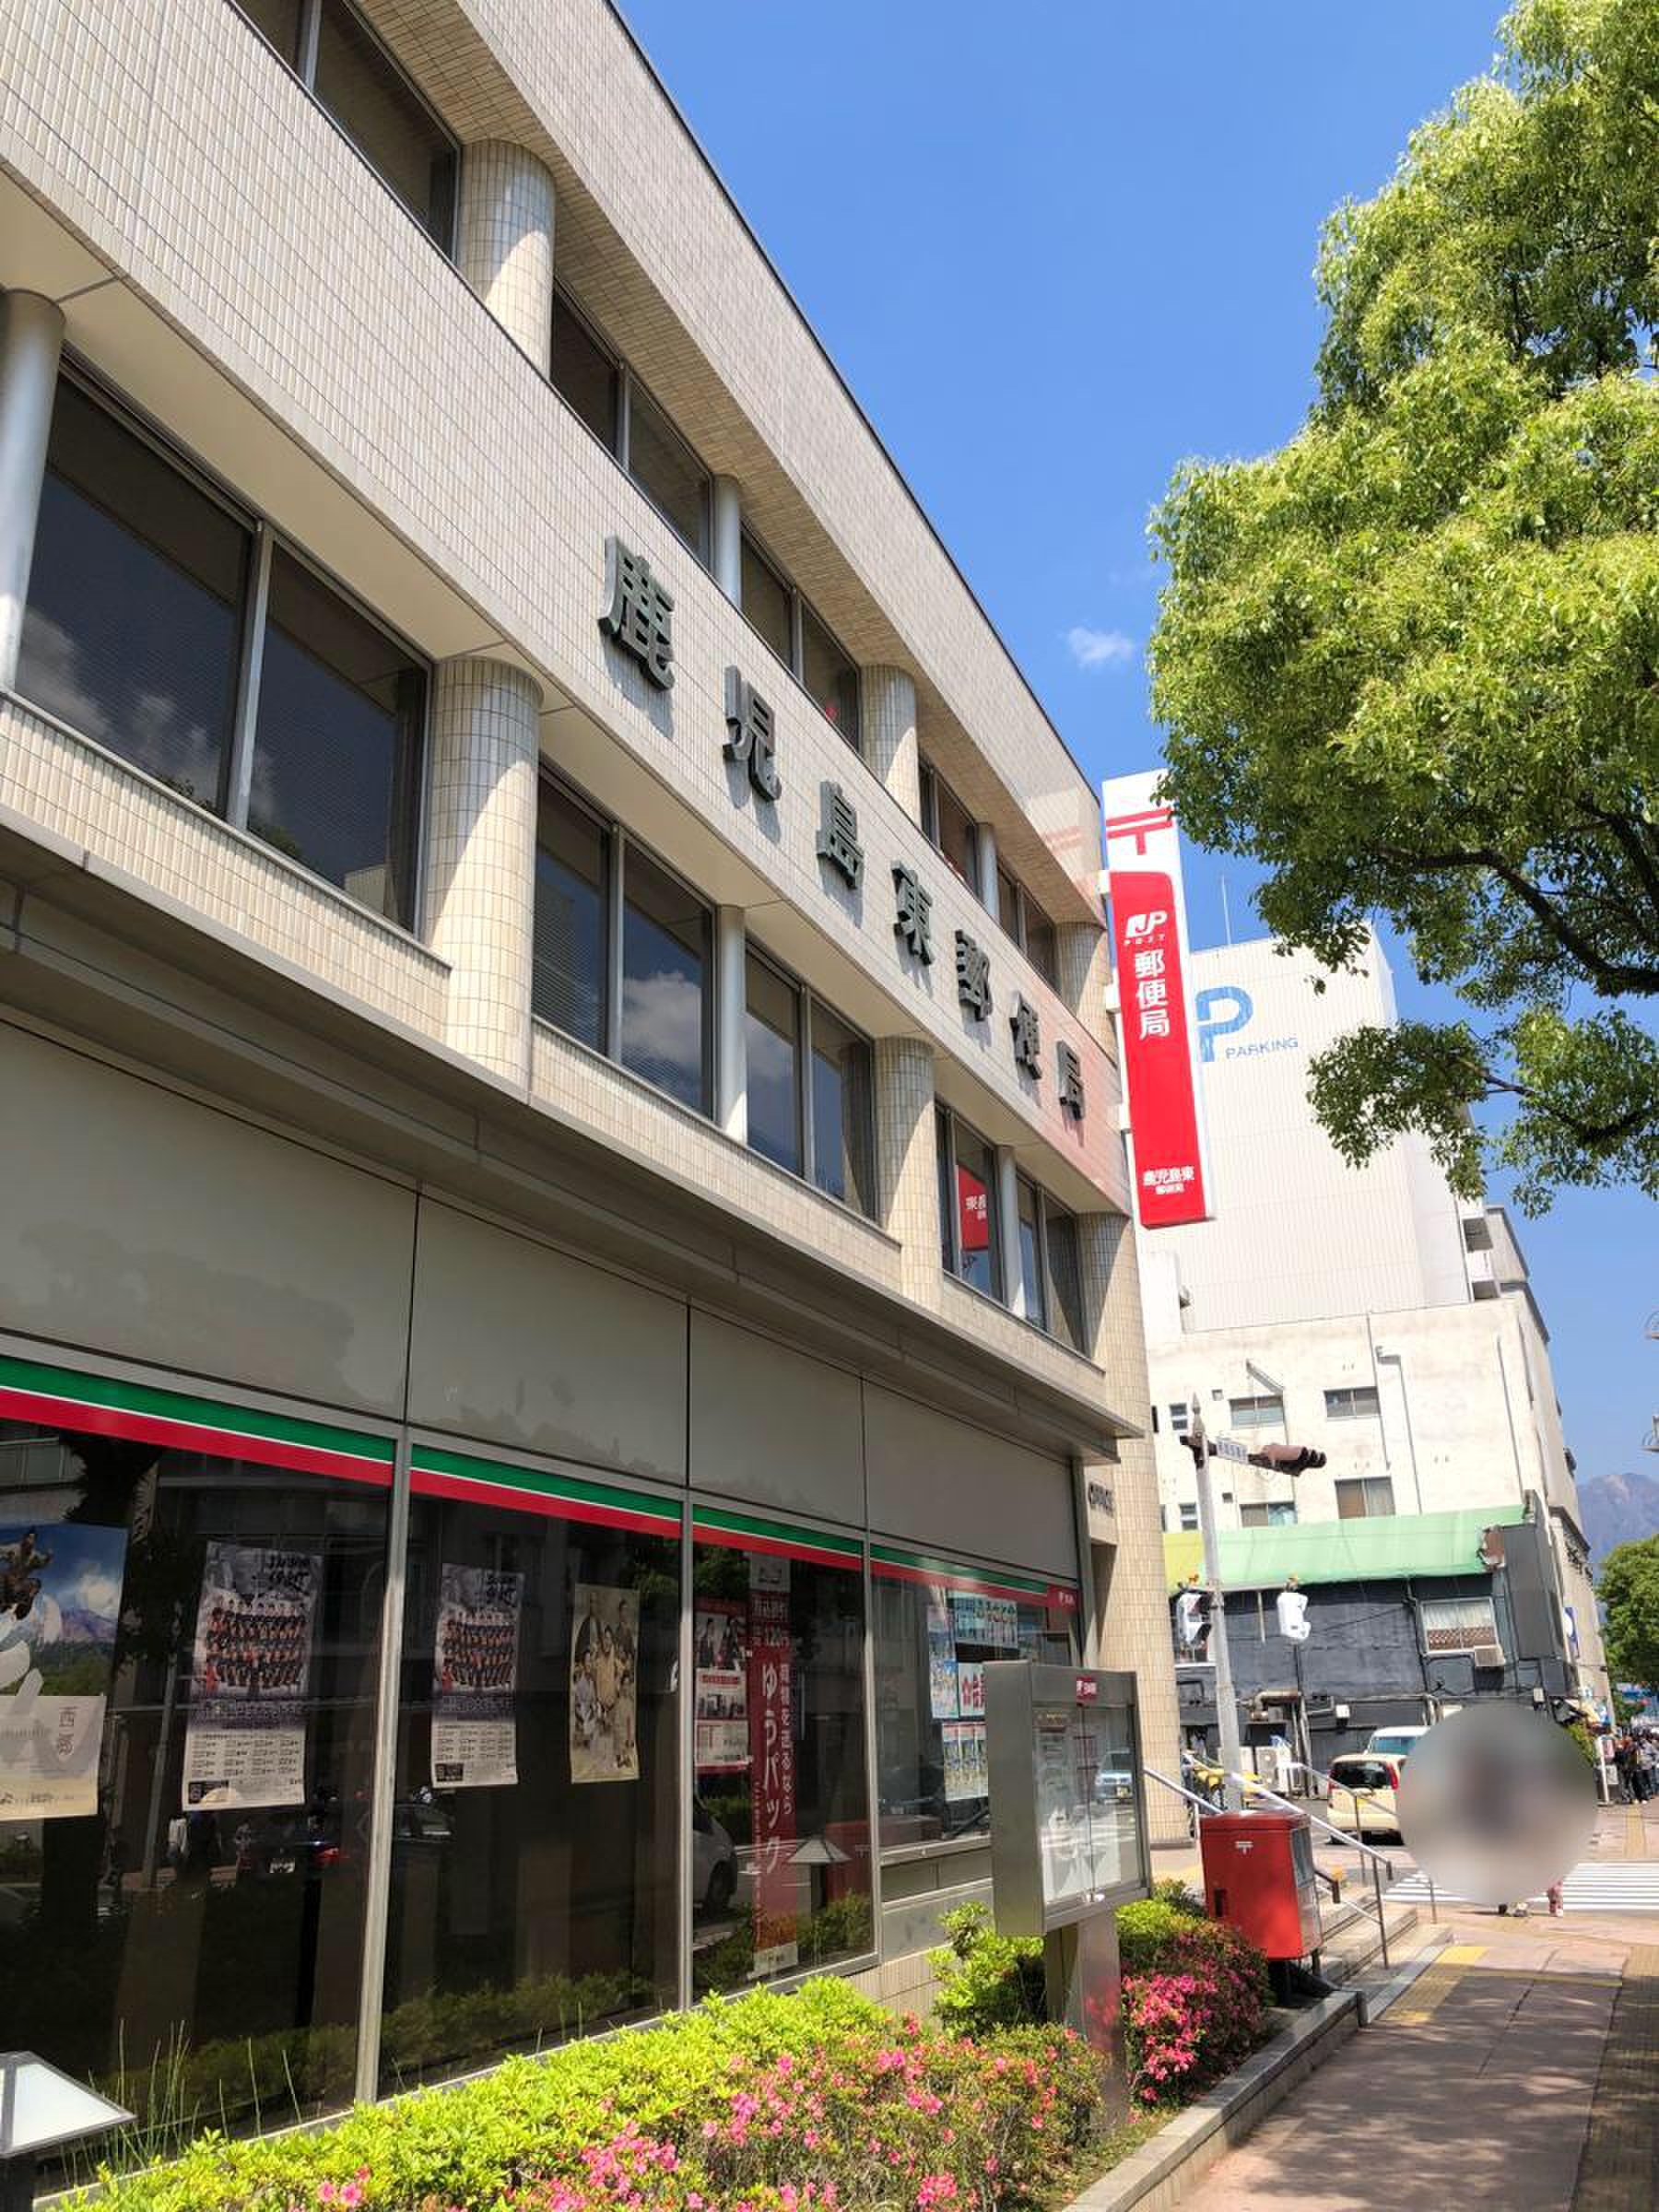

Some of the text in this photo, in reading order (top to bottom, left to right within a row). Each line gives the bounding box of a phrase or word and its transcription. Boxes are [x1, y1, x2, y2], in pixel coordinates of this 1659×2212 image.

[599, 535, 1086, 1121] 鹿児島東郵便局
[1135, 948, 1171, 1041] 郵便局
[1194, 985, 1253, 1062] P
[1225, 1037, 1298, 1059] PARKING
[761, 1662, 781, 1874] ゆうパック
